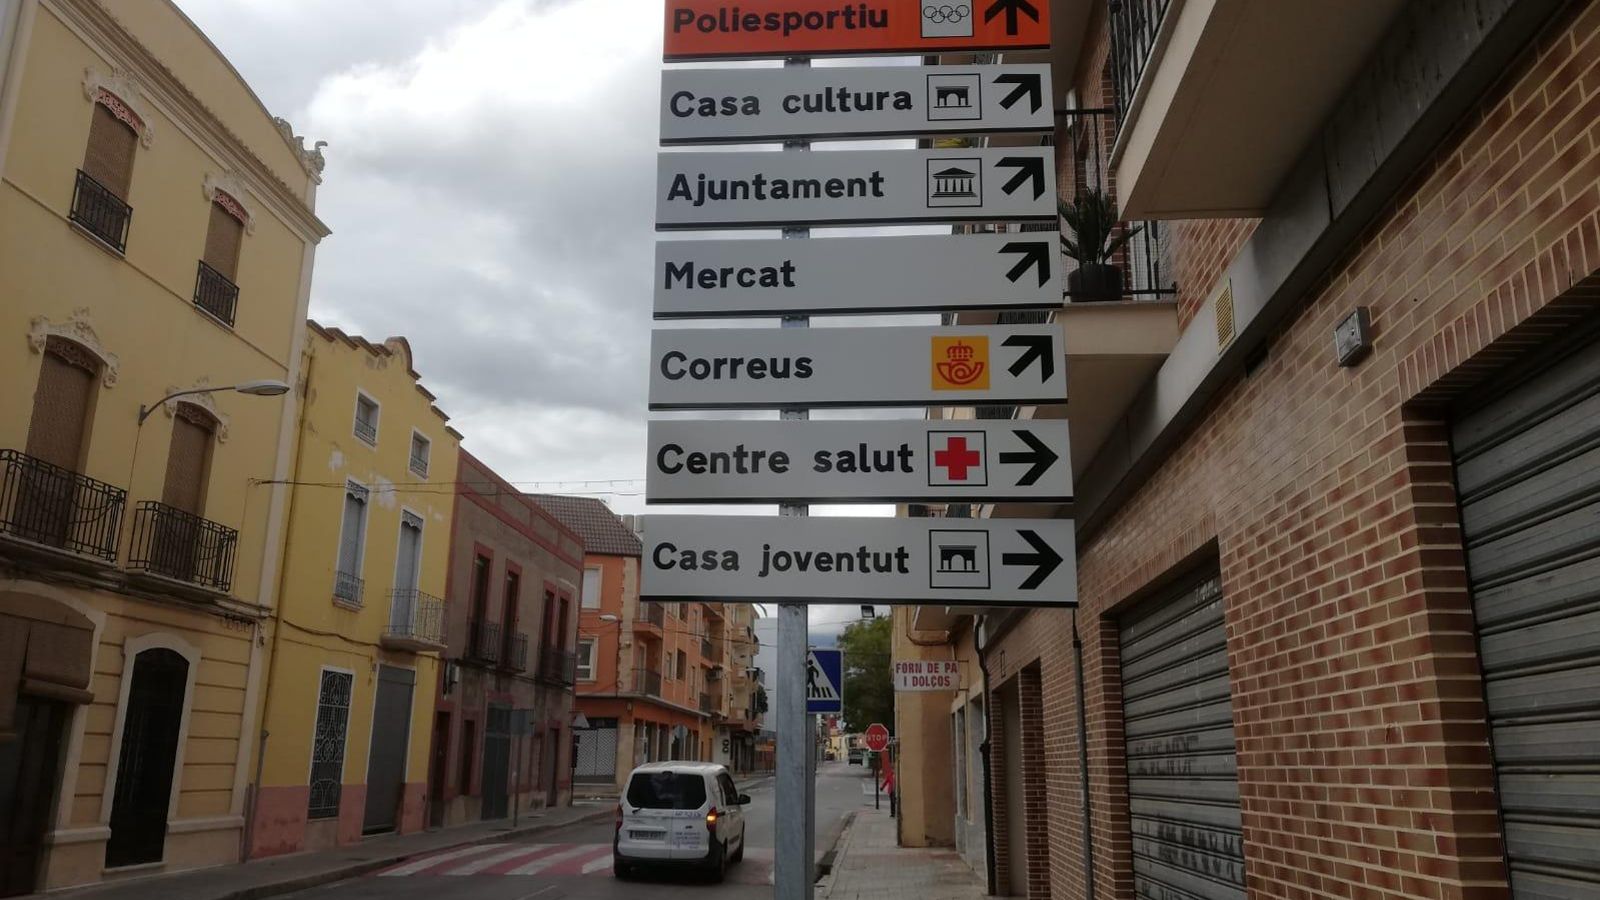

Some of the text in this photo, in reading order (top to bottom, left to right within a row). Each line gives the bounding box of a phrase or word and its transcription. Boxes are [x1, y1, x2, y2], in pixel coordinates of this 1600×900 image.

[673, 3, 889, 37] Poliesportiu
[669, 86, 913, 118] Casa cultura
[666, 170, 885, 207] Ajuntament
[664, 259, 796, 290] Mercat
[660, 350, 814, 381] Correus
[656, 442, 914, 475] Centre salut
[652, 541, 910, 578] Casa joventut
[896, 663, 958, 673] FORN DE PA
[903, 676, 950, 688] I DOLÇOS
[867, 733, 887, 742] STOP
